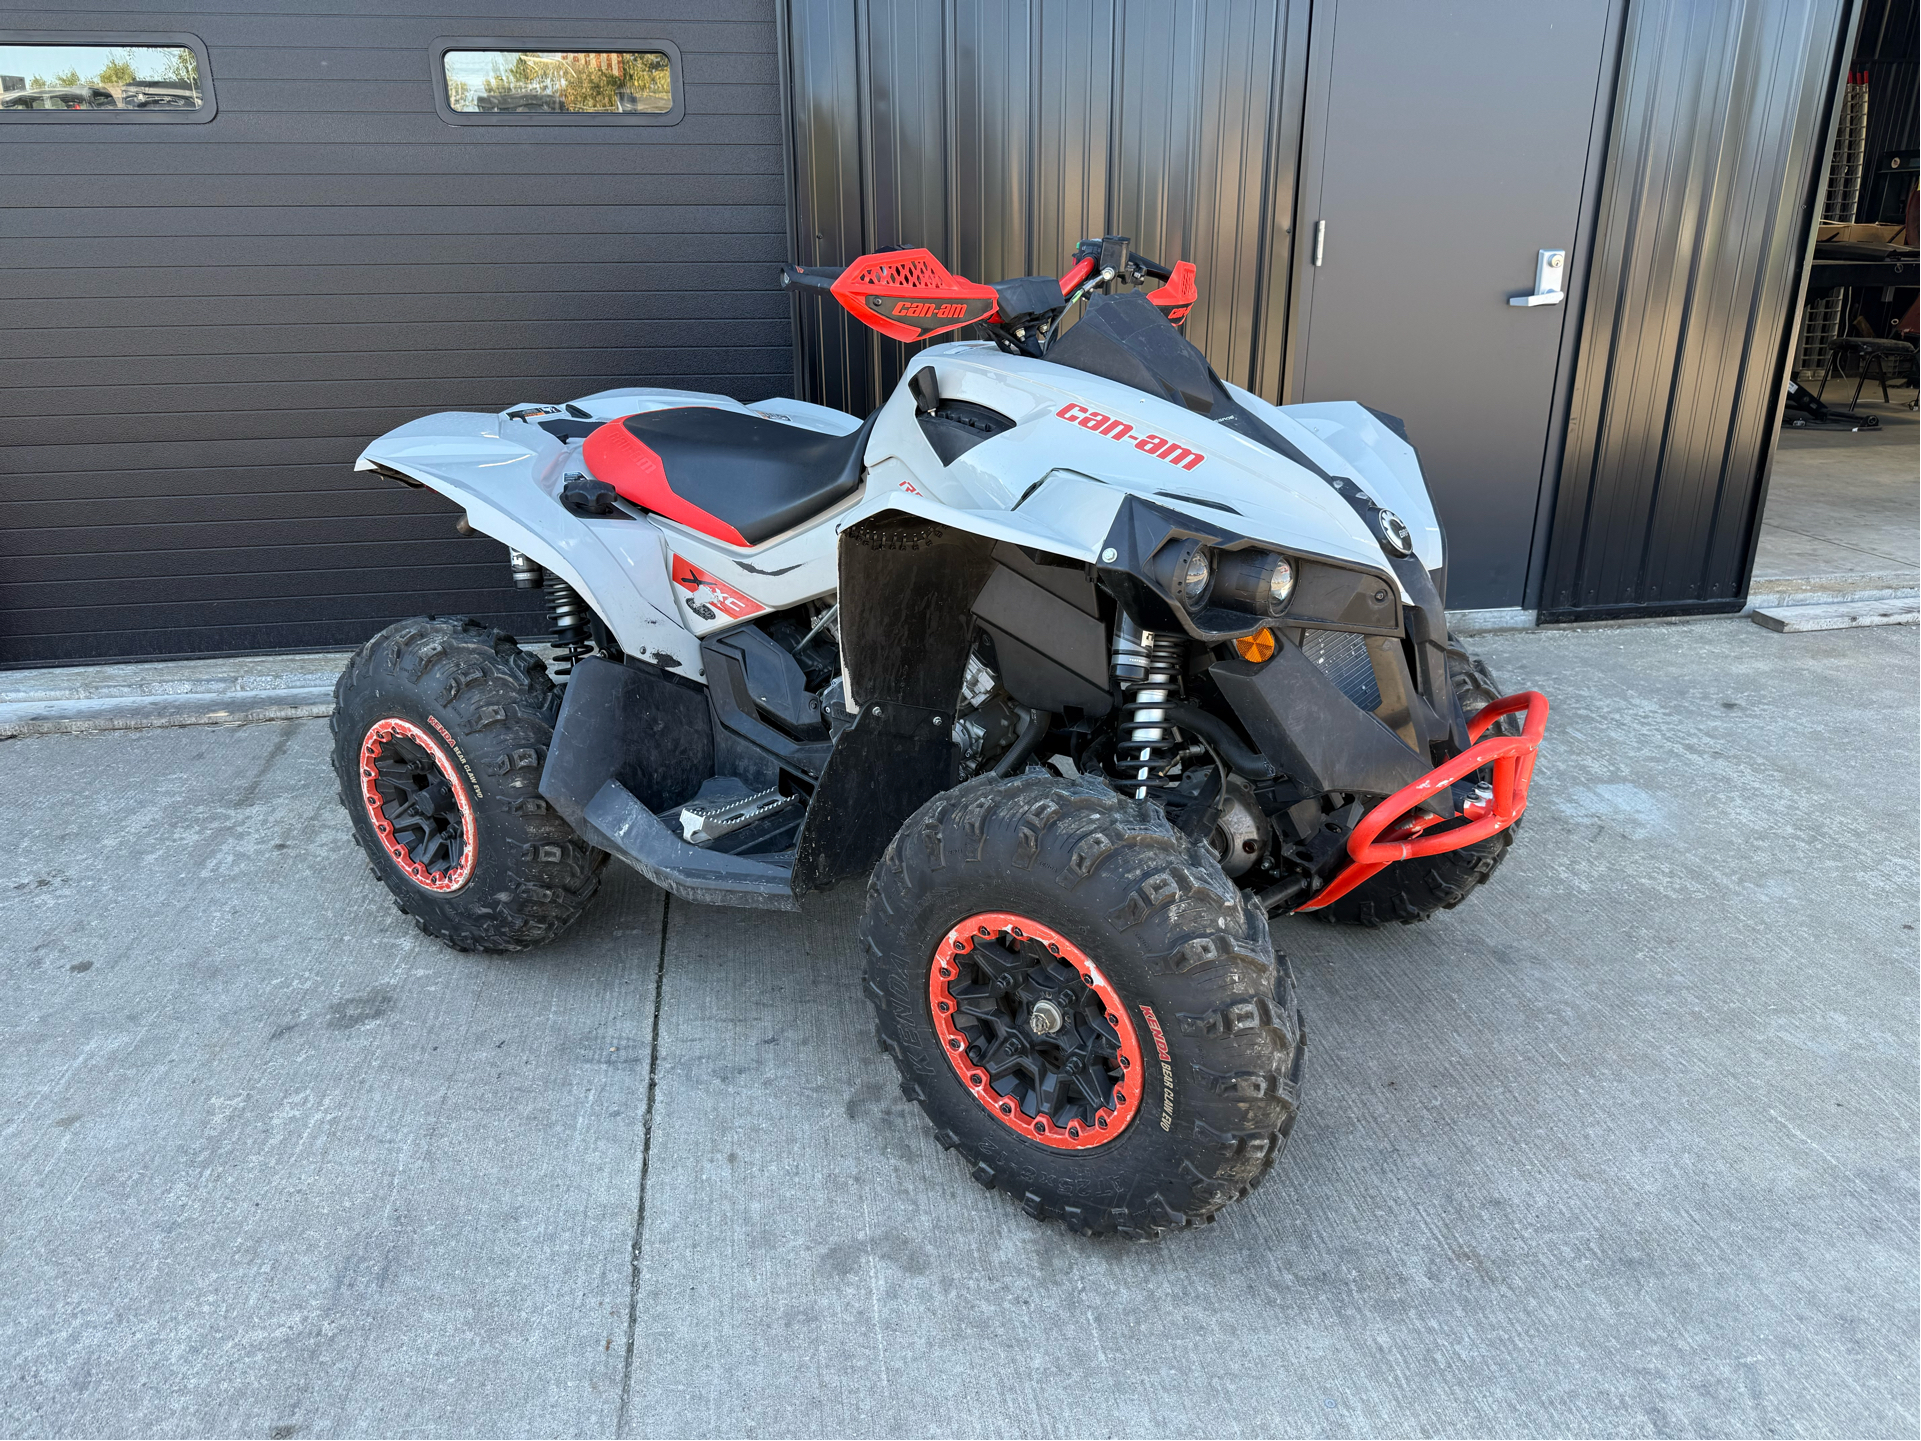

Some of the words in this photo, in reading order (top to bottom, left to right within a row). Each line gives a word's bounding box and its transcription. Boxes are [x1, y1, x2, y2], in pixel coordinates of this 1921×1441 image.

[892, 302, 967, 318] can-am
[607, 431, 657, 474] can-am
[1055, 402, 1205, 472] can-am
[427, 715, 456, 748] KENDA
[453, 746, 467, 764] BEAR
[463, 764, 477, 784] CLAW
[473, 784, 484, 799] EVO
[889, 952, 936, 1075] KENDA
[1139, 1004, 1171, 1062] KENDA
[1161, 1061, 1173, 1089] BEAR
[1160, 1112, 1172, 1132] EVO
[1164, 1087, 1174, 1116] CLAW
